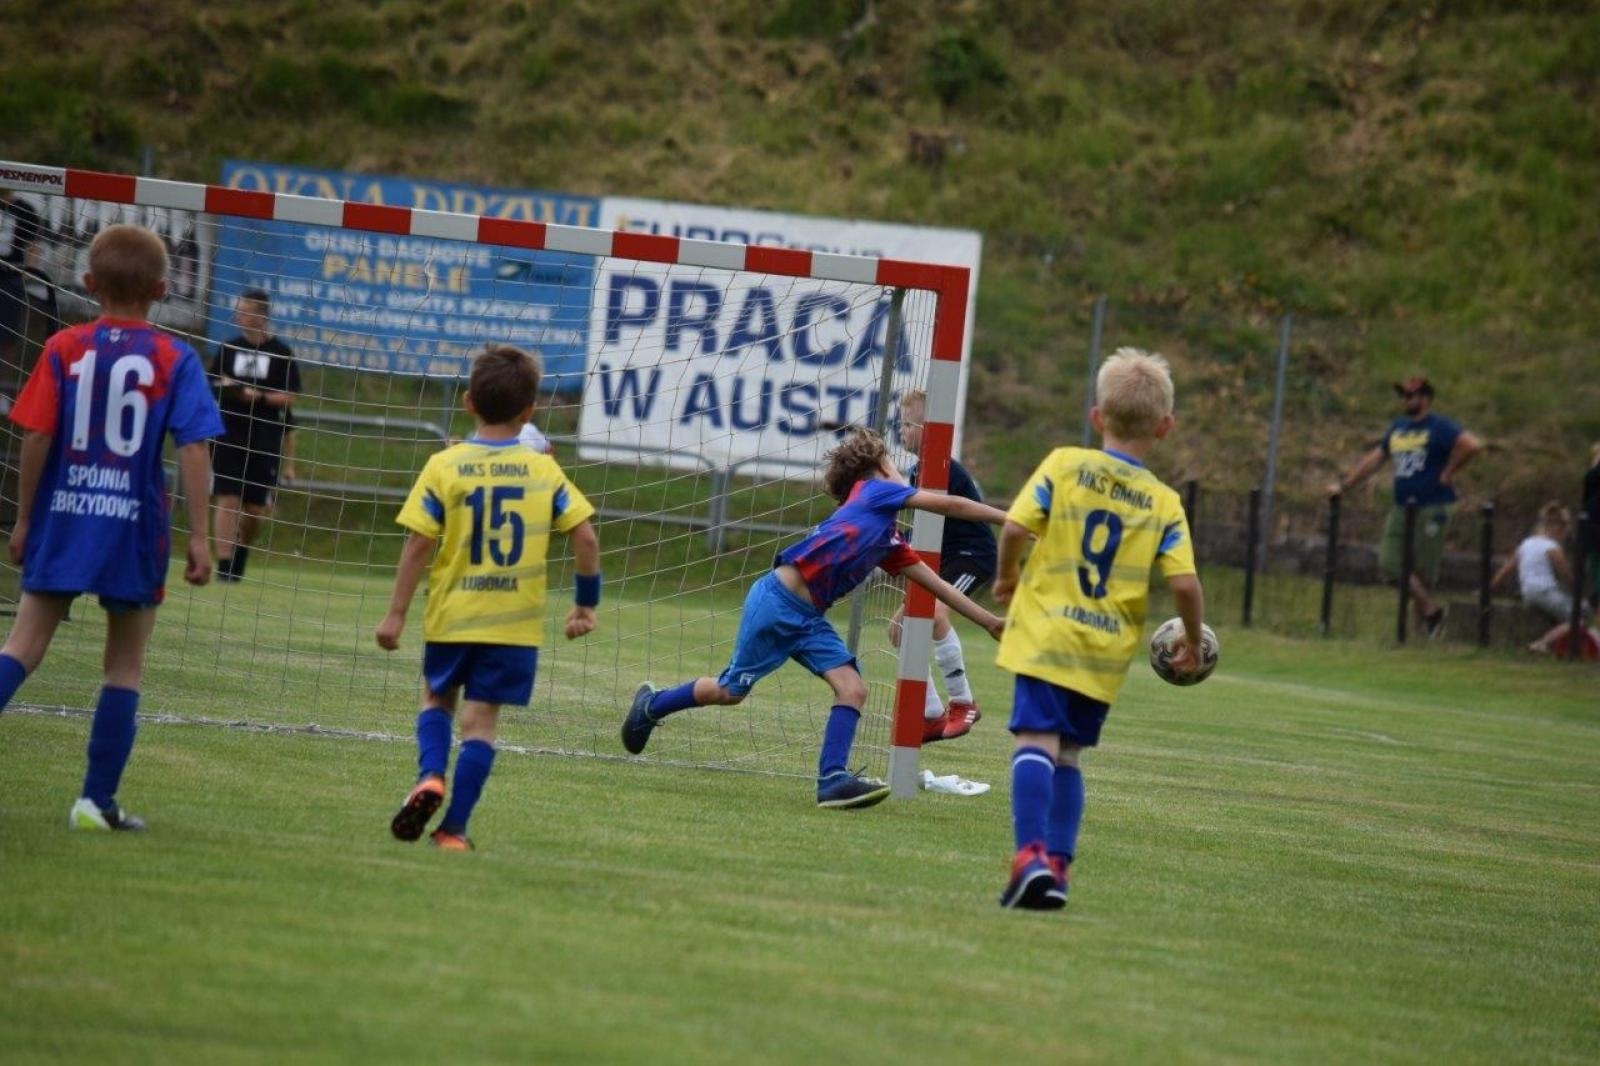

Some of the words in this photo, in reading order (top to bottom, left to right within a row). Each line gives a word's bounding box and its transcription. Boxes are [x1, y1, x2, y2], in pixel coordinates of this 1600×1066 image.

[323, 253, 472, 294] PANELE
[604, 273, 914, 374] PRACA
[69, 349, 155, 458] 16
[600, 363, 662, 422] W
[67, 463, 130, 492] SPÓJNIA
[458, 463, 485, 478] MKS
[489, 463, 529, 478] GMINA
[1077, 469, 1108, 495] MKS
[465, 486, 525, 567] 15
[1077, 508, 1123, 600] 9
[461, 575, 519, 591] LUBOMIA
